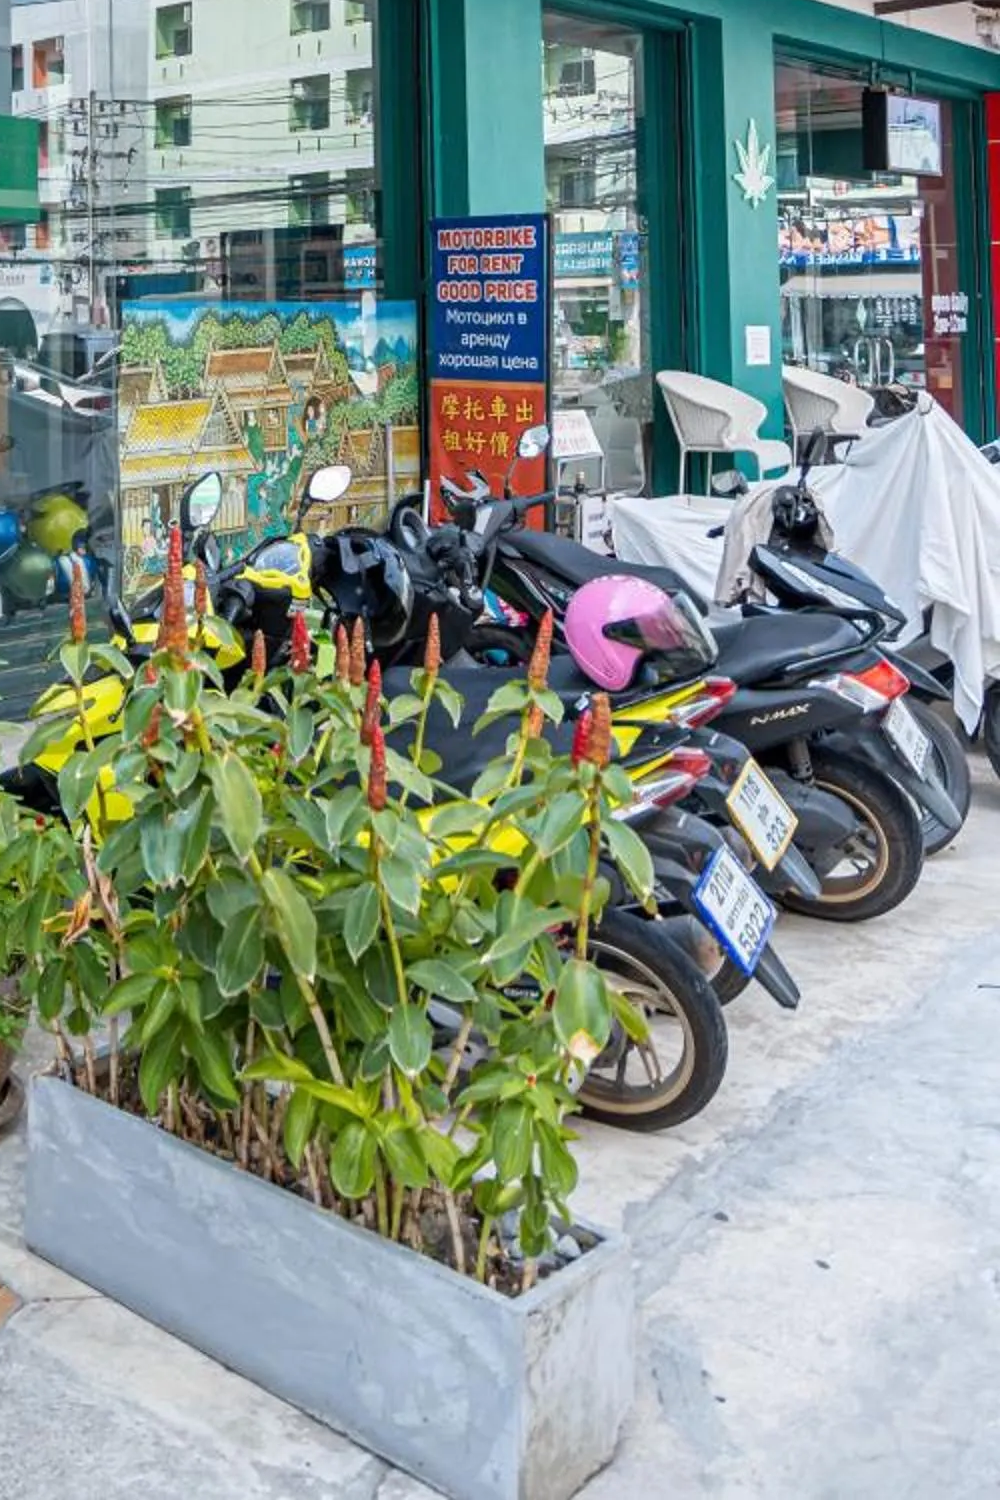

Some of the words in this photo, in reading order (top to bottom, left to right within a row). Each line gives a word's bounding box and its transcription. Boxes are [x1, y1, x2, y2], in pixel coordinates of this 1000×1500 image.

[438, 226, 536, 250] MOTORBIKE
[448, 254, 478, 274] FOR
[480, 254, 524, 274] RENT
[438, 280, 481, 302] GOOD
[484, 280, 537, 302] PRICE
[446, 308, 514, 326] Мотоцикл
[517, 311, 527, 325] в
[461, 332, 511, 350] аренду
[439, 354, 499, 369] хорошая
[501, 356, 538, 370] цена
[440, 392, 533, 424] 摩托車出
